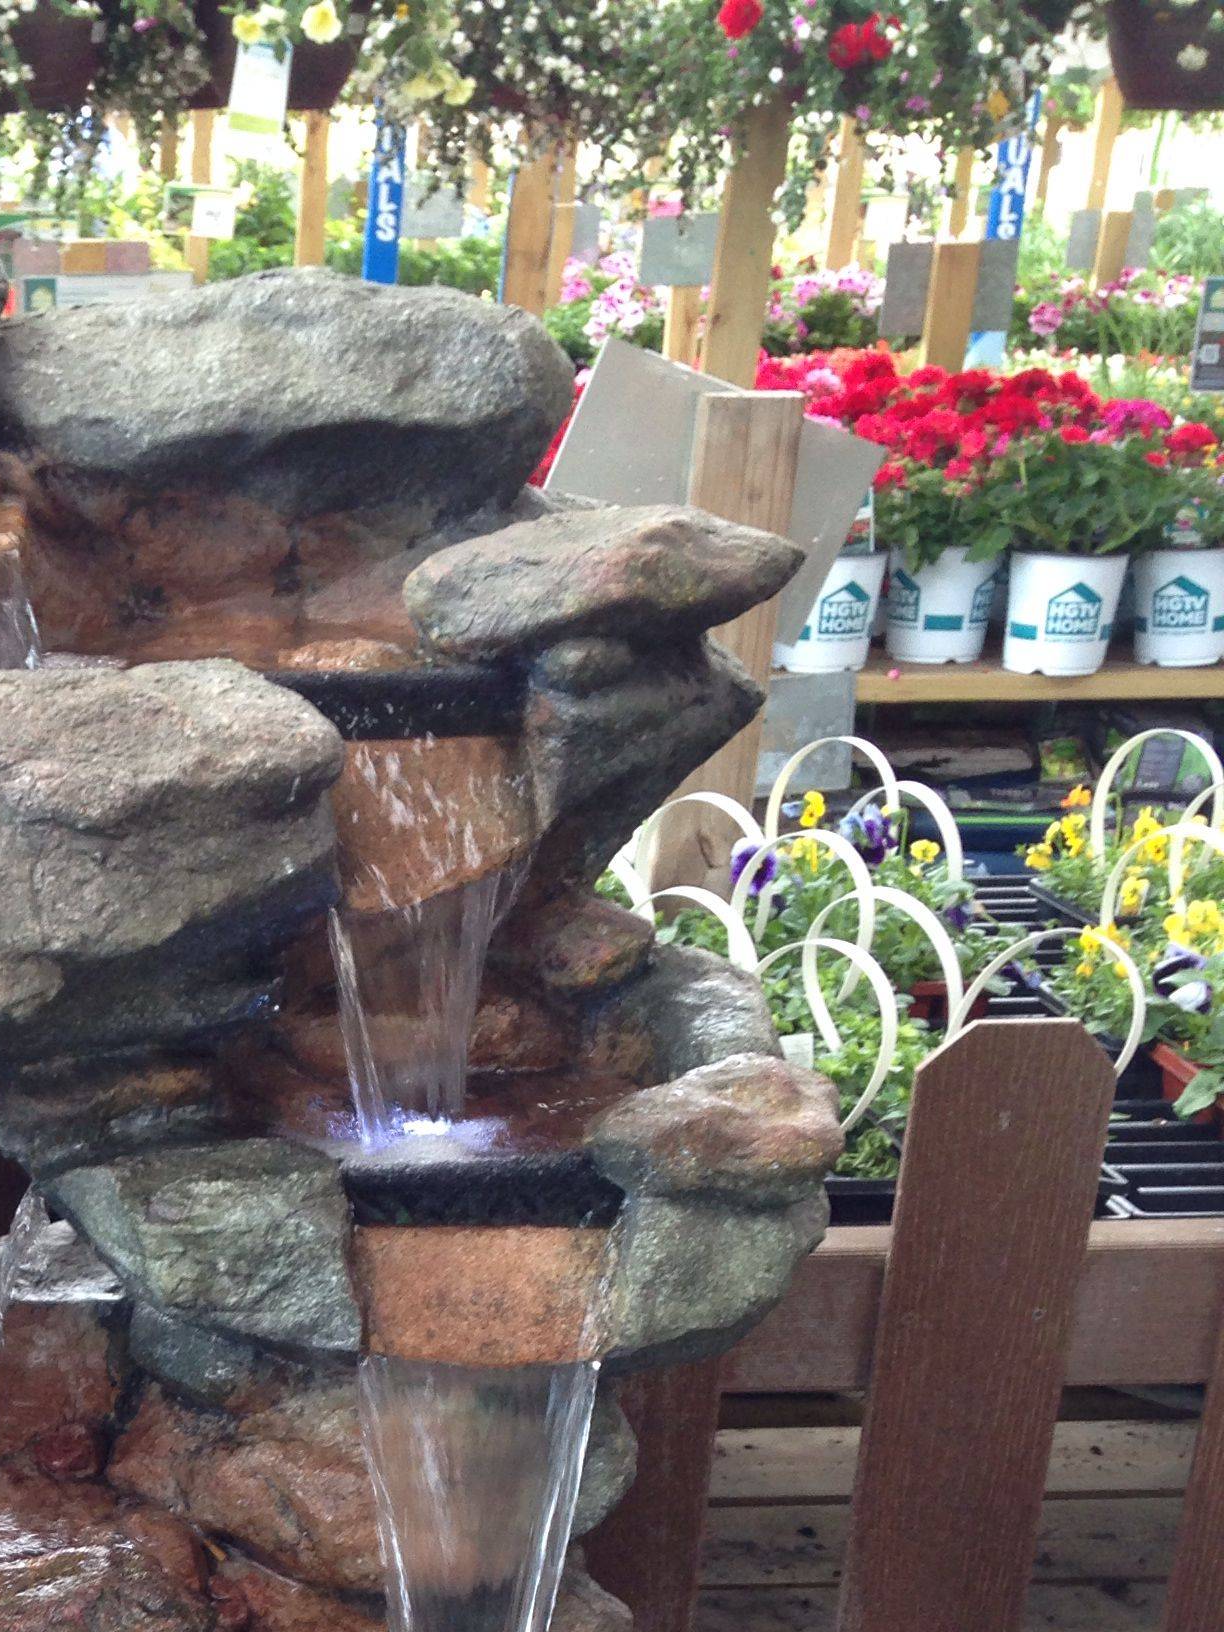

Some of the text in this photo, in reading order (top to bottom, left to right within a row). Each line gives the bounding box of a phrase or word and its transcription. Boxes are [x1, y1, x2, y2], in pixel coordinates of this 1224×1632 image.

[1049, 602, 1099, 618] HGTV
[1153, 595, 1206, 611] HGTV
[1047, 618, 1097, 633] HOME
[1153, 611, 1205, 626] HOME
